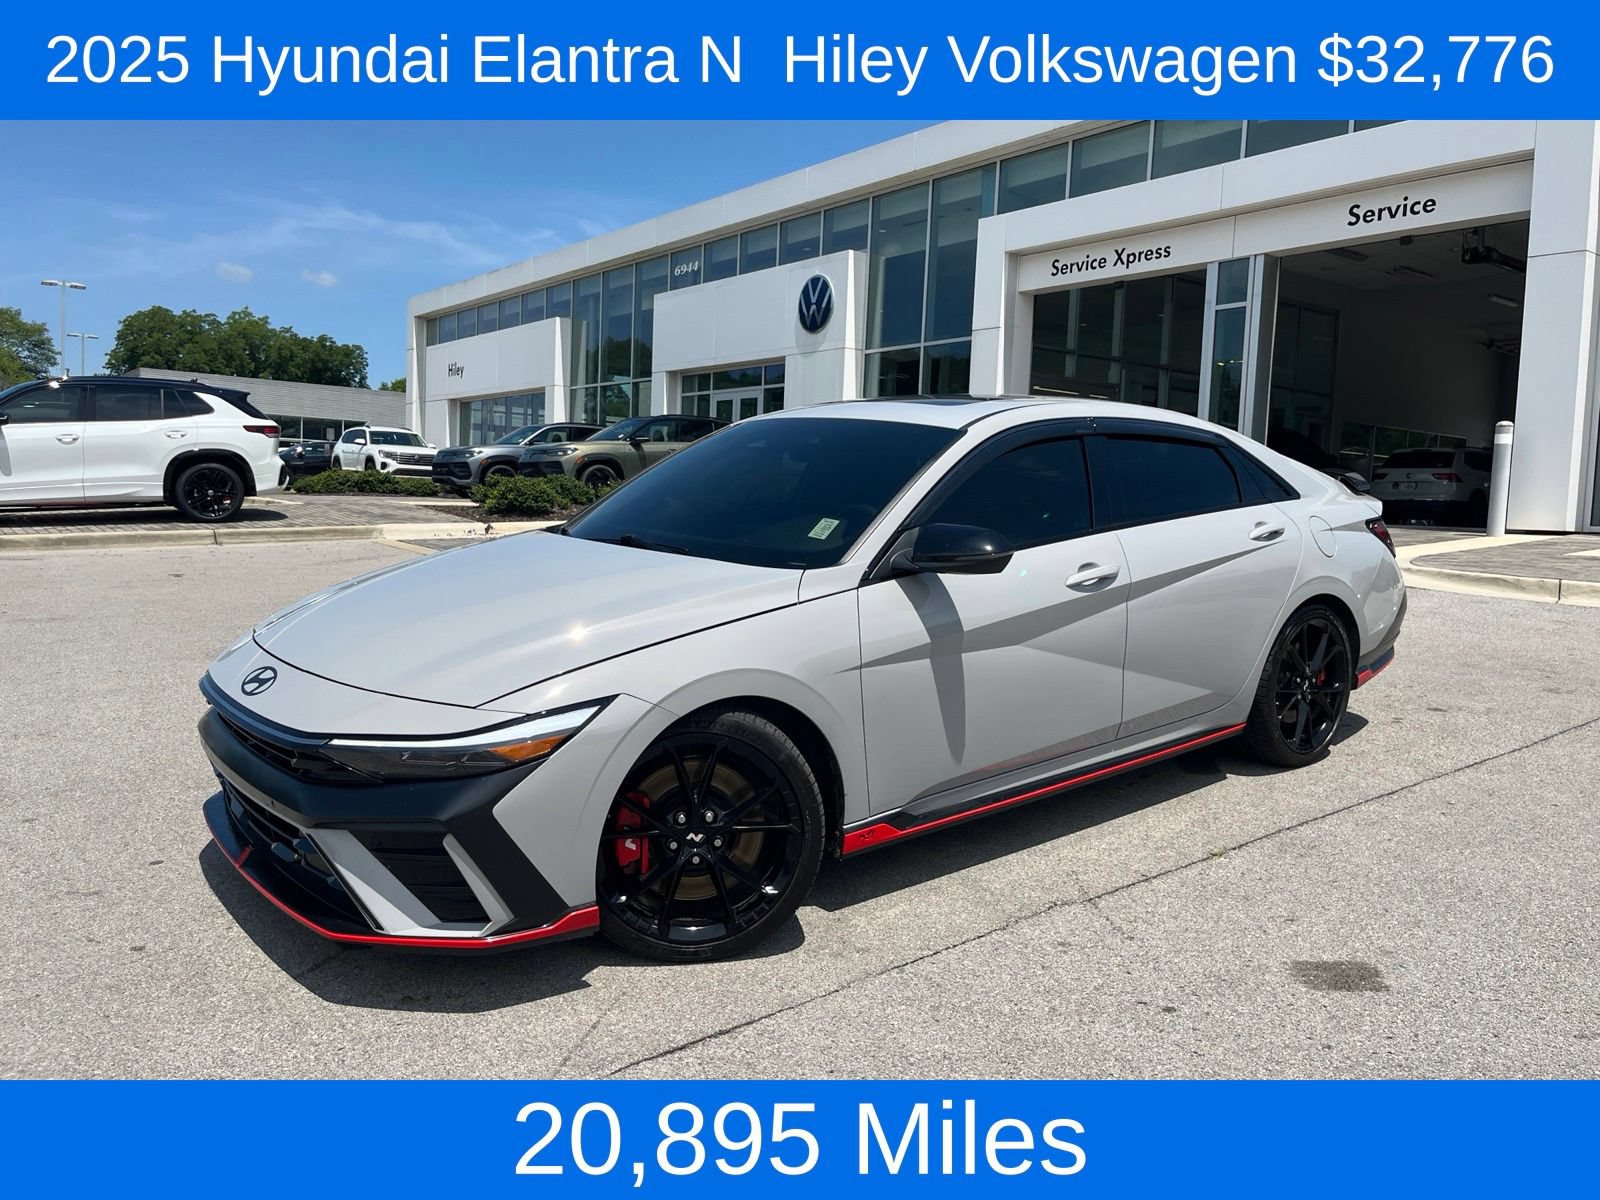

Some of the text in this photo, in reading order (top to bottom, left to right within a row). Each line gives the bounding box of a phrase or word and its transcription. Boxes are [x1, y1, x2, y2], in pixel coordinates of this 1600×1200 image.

[1347, 195, 1437, 227] Service
[674, 260, 699, 277] 6944
[1050, 245, 1172, 278] Service Xpress
[448, 361, 465, 379] Hiley
